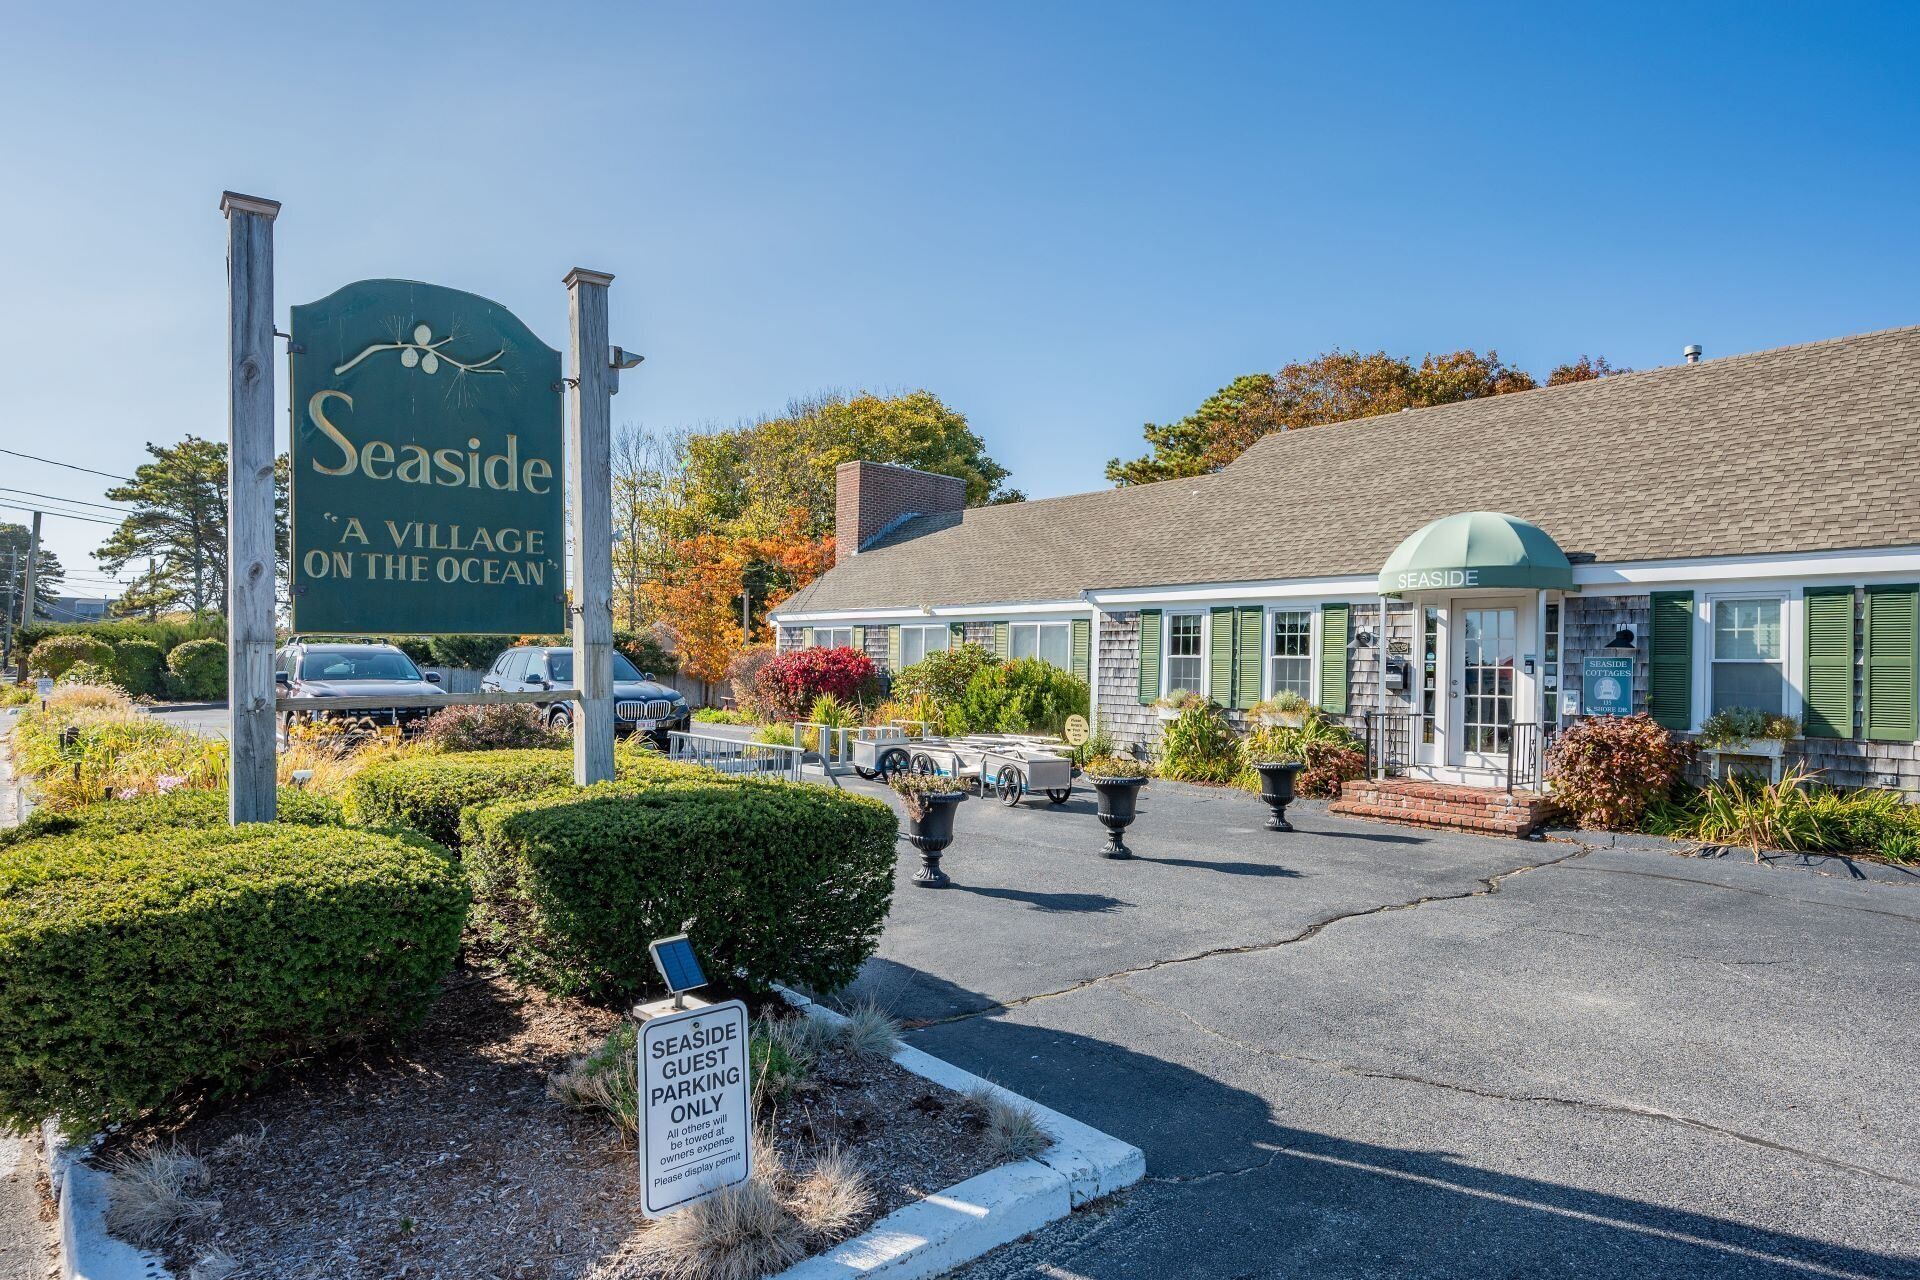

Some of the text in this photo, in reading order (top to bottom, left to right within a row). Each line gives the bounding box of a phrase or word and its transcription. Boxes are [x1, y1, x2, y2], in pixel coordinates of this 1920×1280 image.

[309, 389, 553, 494] Seaside
[384, 520, 545, 555] VILLAGE
[303, 550, 353, 579] ON
[361, 552, 429, 582] THE
[1398, 570, 1479, 589] SEASIDE
[1585, 669, 1632, 677] COTTAGES
[1590, 660, 1627, 668] SEASIDE
[651, 1022, 737, 1060] SEASIDE
[662, 1046, 729, 1080] GUEST
[651, 1066, 740, 1107] PARKING
[670, 1092, 724, 1124] ONLY
[666, 1113, 728, 1141] All others will
[670, 1126, 725, 1151] be towed at
[660, 1135, 735, 1166] owners expense
[654, 1151, 741, 1188] Please display permit
